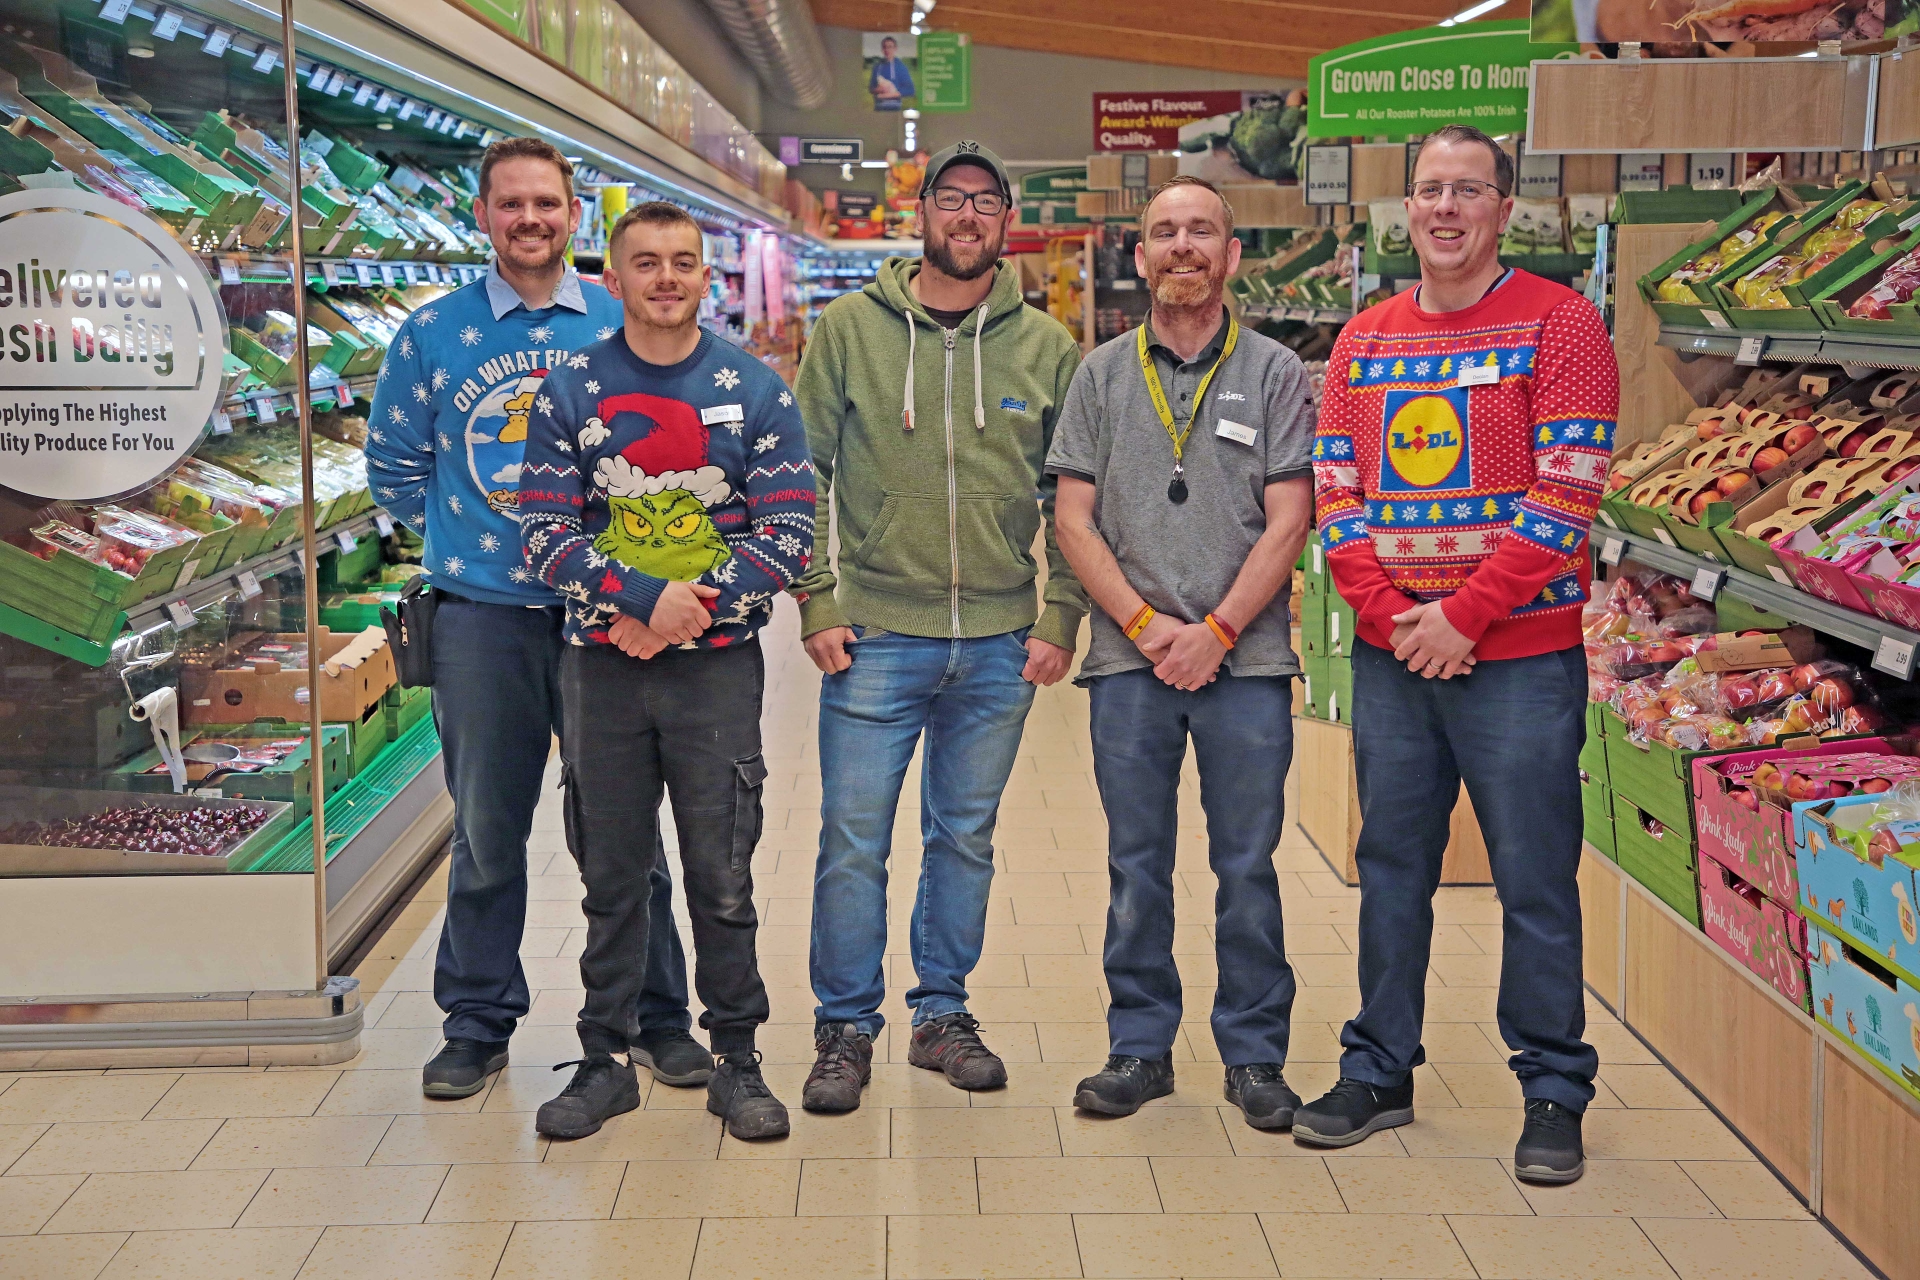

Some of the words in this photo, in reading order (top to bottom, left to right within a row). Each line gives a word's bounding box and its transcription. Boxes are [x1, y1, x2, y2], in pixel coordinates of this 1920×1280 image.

[1331, 68, 1395, 93] Grown
[1401, 66, 1455, 91] Close
[1460, 64, 1482, 90] To
[1099, 98, 1150, 112] Festive
[1152, 98, 1207, 112] Flavour.
[1356, 108, 1367, 119] All
[1369, 108, 1385, 119] Our
[1386, 106, 1418, 119] Rooster
[1419, 106, 1456, 118] Potatoes
[1457, 105, 1472, 117] Are
[1473, 104, 1496, 116] 100%
[1497, 105, 1517, 116] Irish
[1100, 131, 1156, 149] Quality.
[1697, 166, 1724, 180] 1.19
[71, 313, 174, 377] Daily
[453, 377, 487, 413] OH,
[477, 350, 540, 387] WHAT
[63, 403, 95, 422] The
[99, 402, 167, 427] Highest
[34, 433, 107, 452] Produce
[112, 434, 139, 451] For
[142, 433, 175, 452] You
[1226, 428, 1248, 440] James
[1895, 651, 1908, 665] 2.99
[1726, 760, 1757, 775] Pink
[1699, 804, 1722, 842] Pink
[1722, 822, 1747, 863] Lady
[1704, 893, 1727, 931] Pink
[1724, 916, 1751, 956] Lady
[1851, 914, 1879, 944] OAKLANDS
[1863, 1030, 1892, 1062] OAKLANDS
